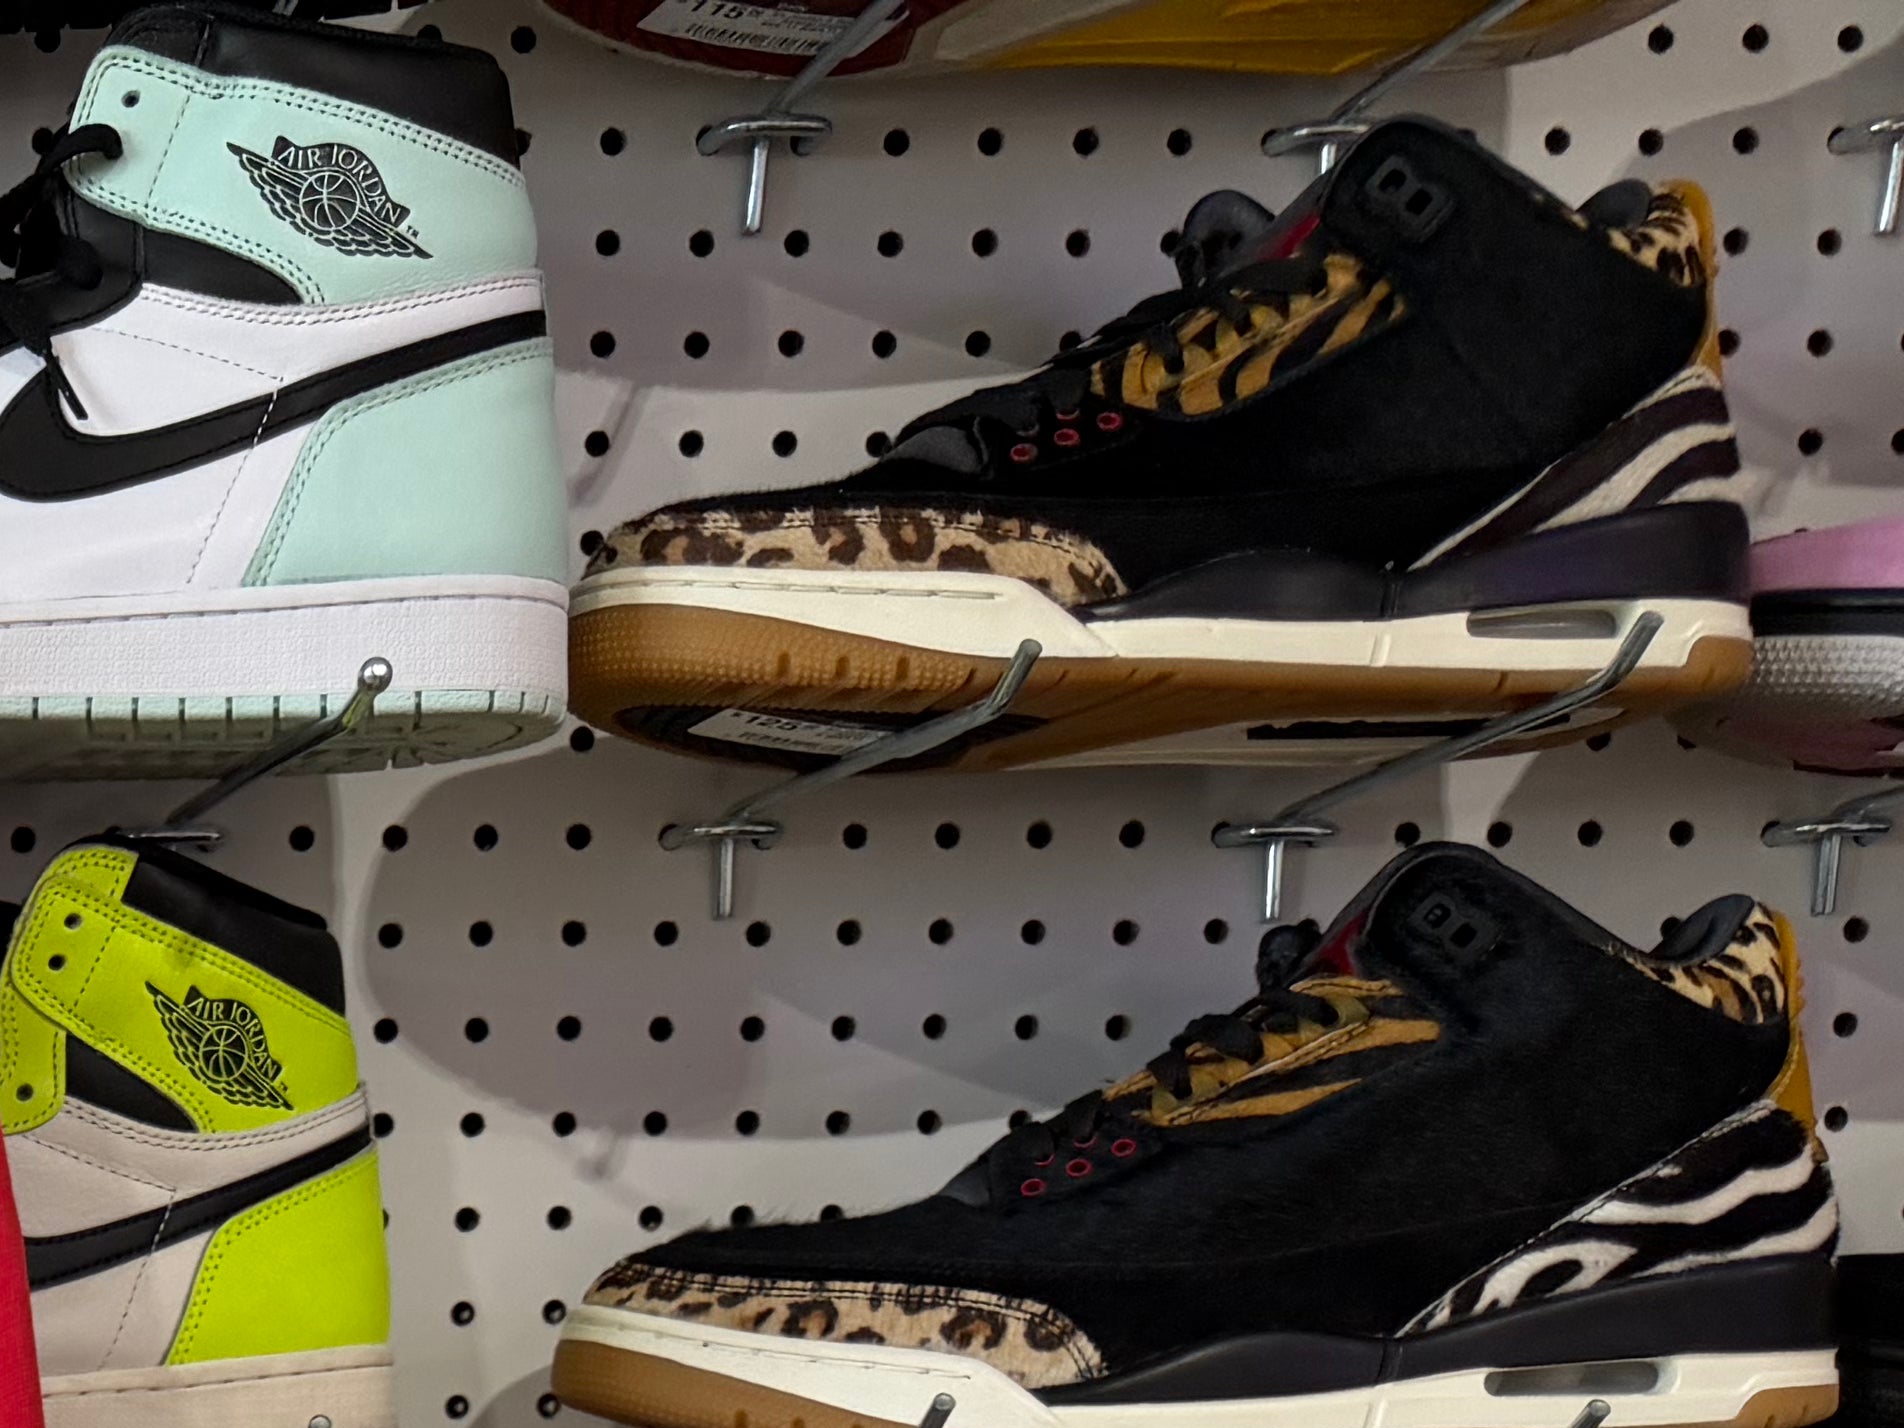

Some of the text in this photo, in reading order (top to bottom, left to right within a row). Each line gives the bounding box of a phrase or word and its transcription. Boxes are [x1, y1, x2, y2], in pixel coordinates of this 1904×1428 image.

[278, 147, 321, 169] AIR
[332, 144, 401, 223] JORDAN
[187, 997, 278, 1078] AIR JORDAN
